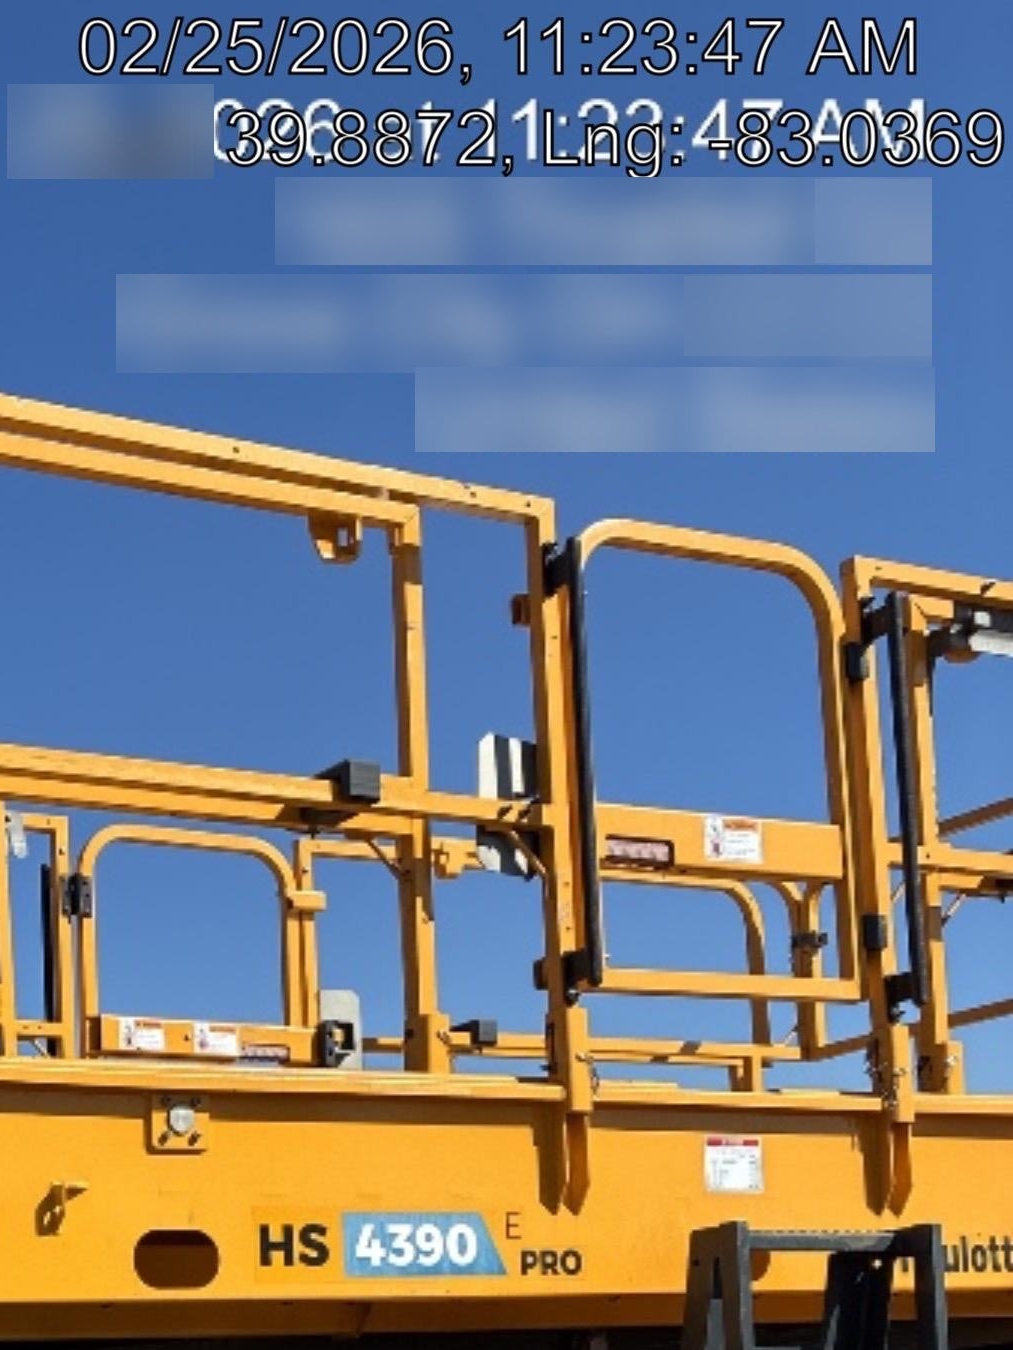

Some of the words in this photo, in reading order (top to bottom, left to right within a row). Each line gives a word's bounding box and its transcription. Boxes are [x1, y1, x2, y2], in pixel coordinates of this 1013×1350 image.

[259, 1223, 330, 1267] HS
[355, 1223, 478, 1266] 4390
[505, 1210, 523, 1240] E
[520, 1249, 583, 1276] PRO
